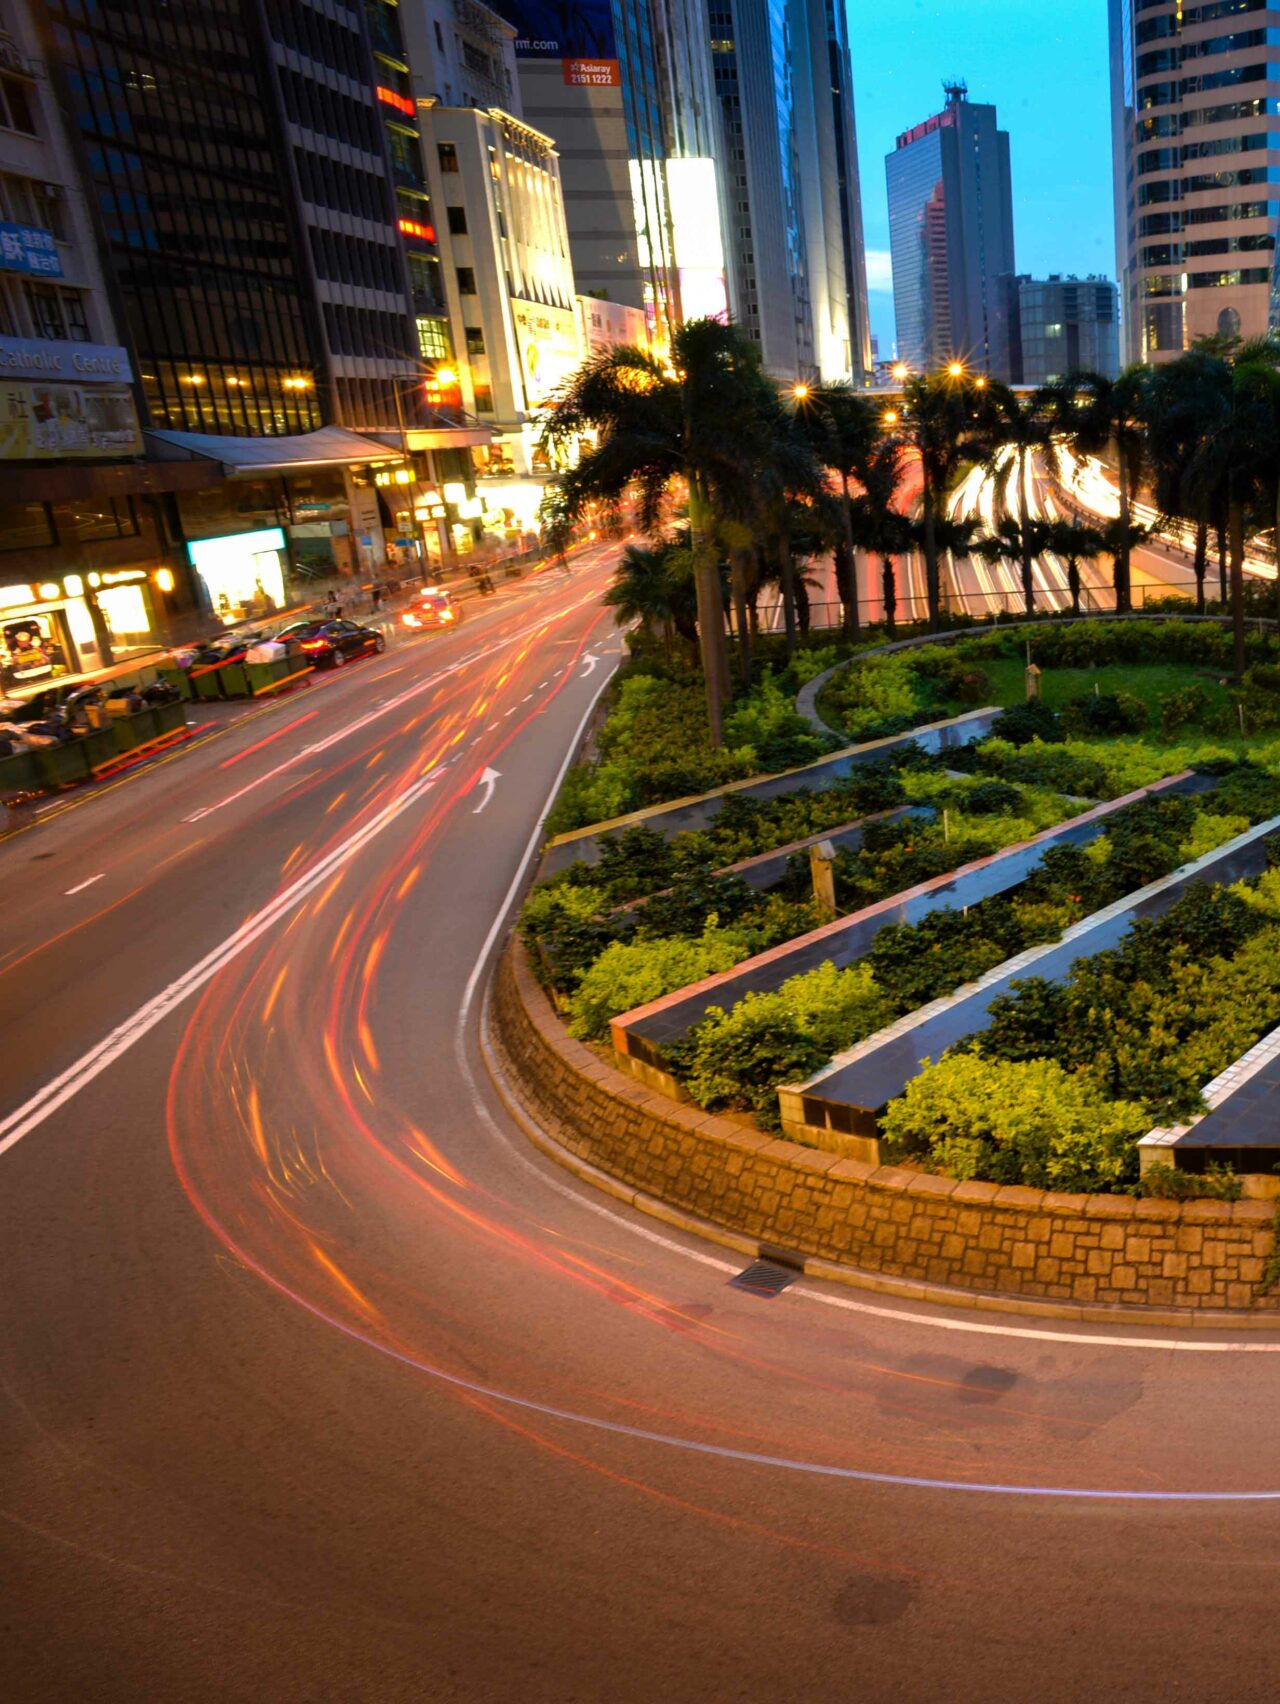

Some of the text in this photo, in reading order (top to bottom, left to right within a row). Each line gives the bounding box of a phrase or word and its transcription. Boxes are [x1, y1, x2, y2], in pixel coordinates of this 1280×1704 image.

[580, 63, 611, 74] Asiaray
[571, 75, 612, 84] 2151 1222
[0, 347, 121, 375] Catholic Centre
